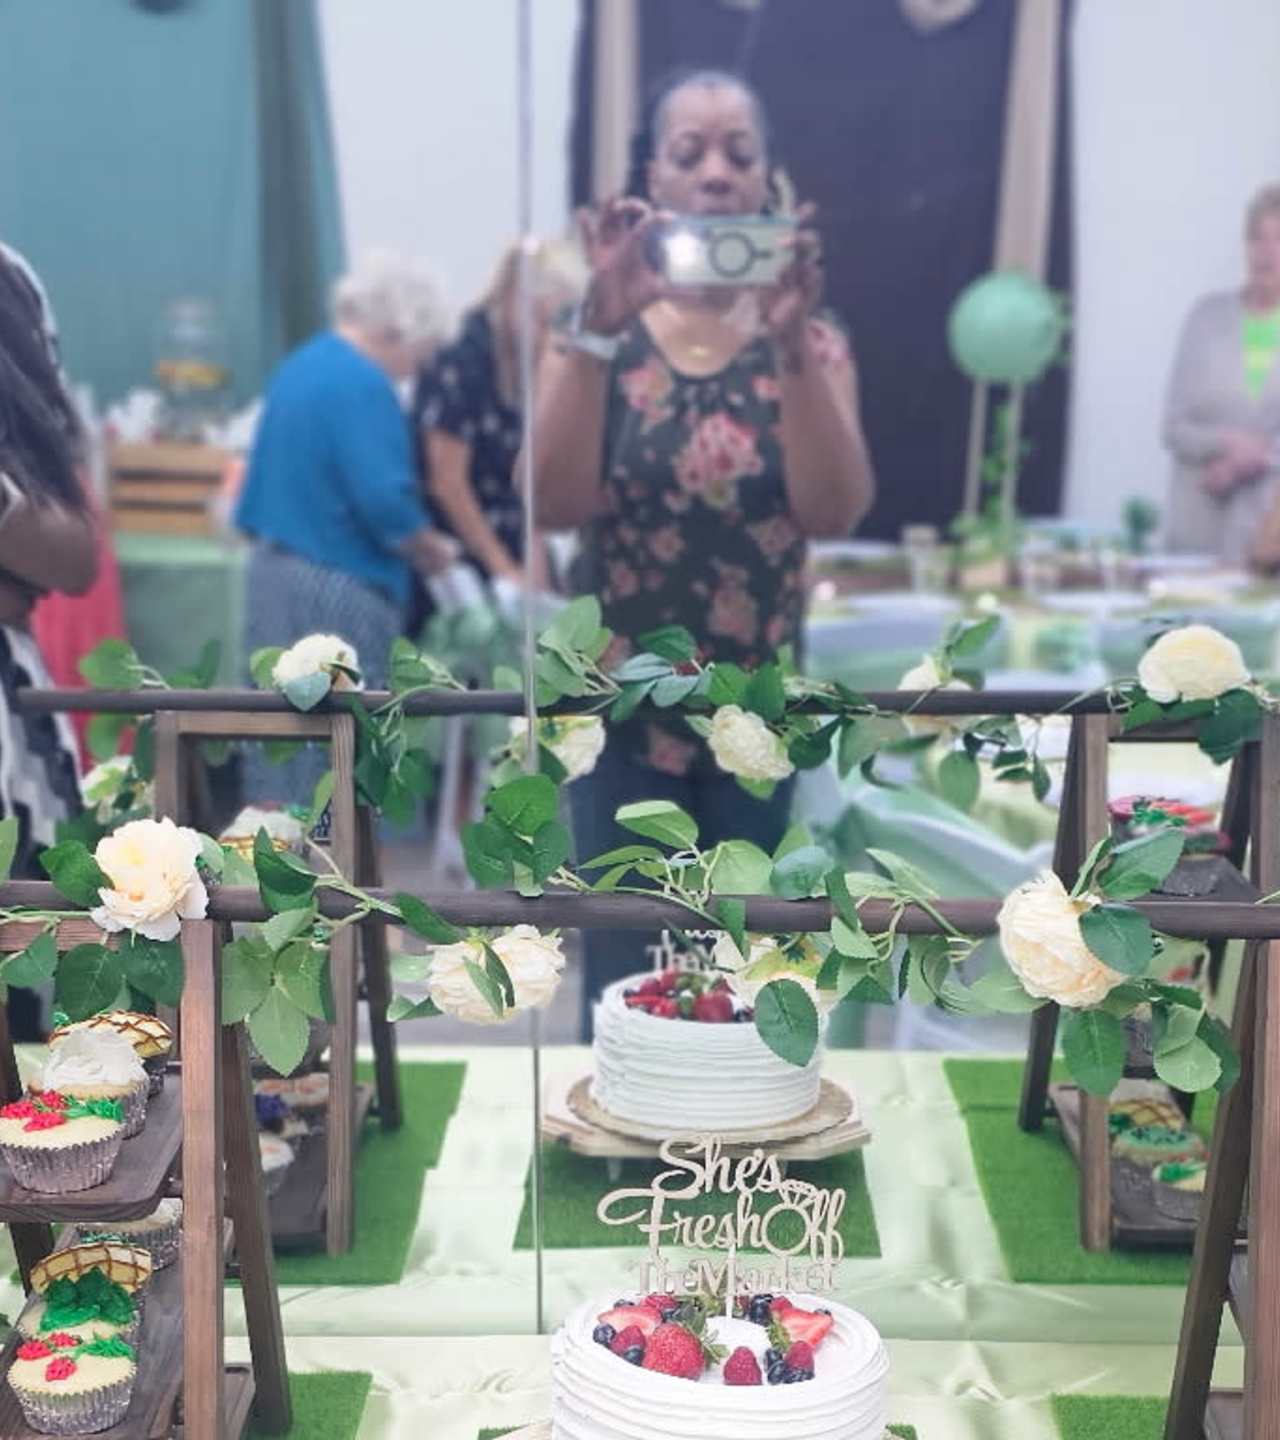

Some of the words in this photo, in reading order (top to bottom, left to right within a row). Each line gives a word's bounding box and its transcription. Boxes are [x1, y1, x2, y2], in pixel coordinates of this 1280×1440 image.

[651, 1133, 781, 1199] She's
[597, 1188, 763, 1256] Fresh
[761, 1186, 846, 1267] Off
[639, 1255, 698, 1295] The
[697, 1257, 836, 1296] Market
